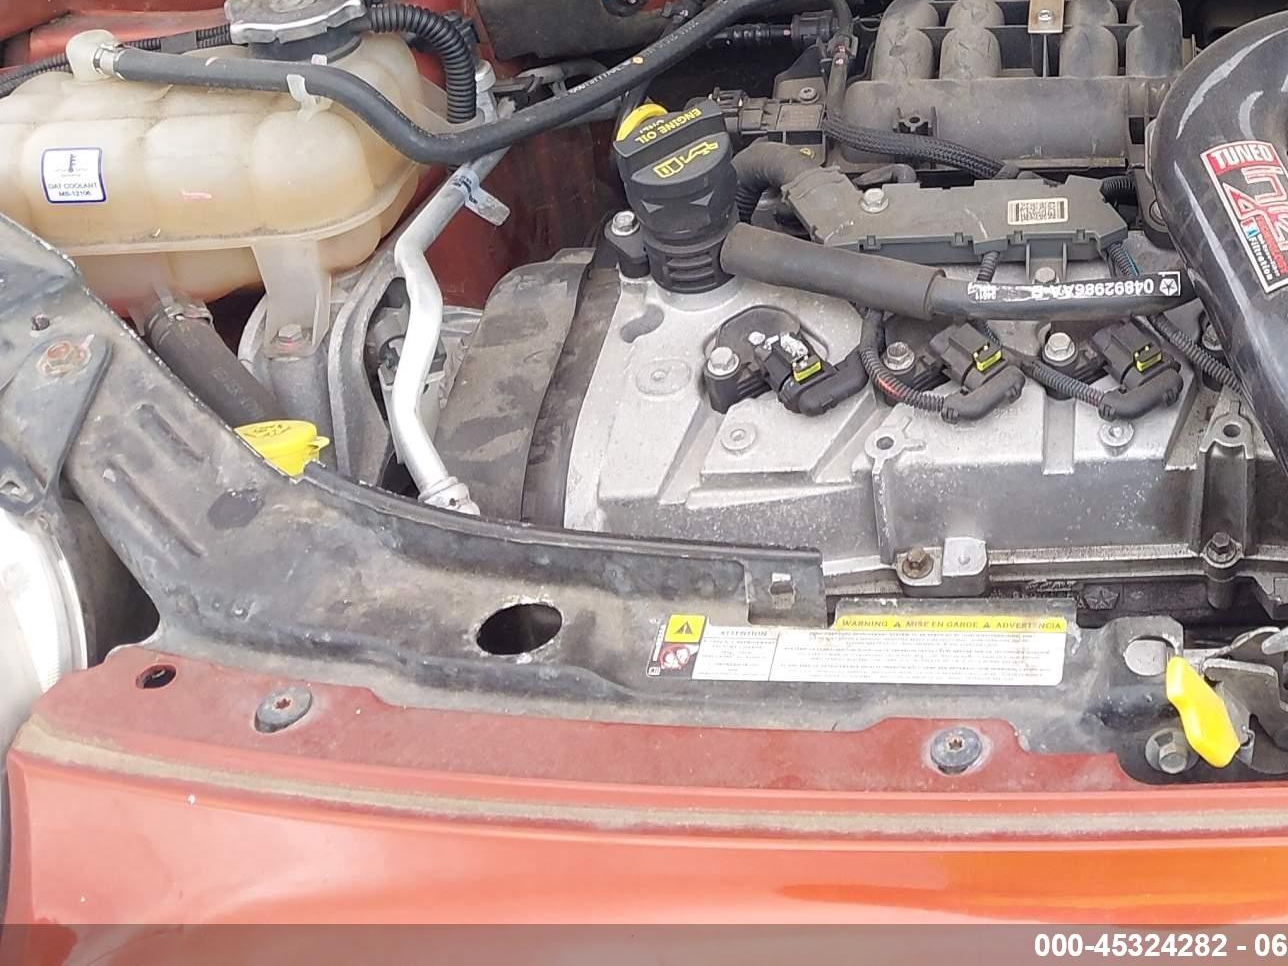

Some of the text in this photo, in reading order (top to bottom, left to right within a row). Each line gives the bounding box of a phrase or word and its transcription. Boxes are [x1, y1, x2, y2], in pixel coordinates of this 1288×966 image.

[634, 108, 702, 144] ENGINE OIL
[1210, 144, 1273, 170] TUNED
[63, 182, 97, 190] COOLANT
[1248, 237, 1273, 281] Filtration
[842, 620, 888, 628] WARNING
[948, 621, 978, 629] GARDE
[995, 622, 1061, 630] ADVERTNCIA
